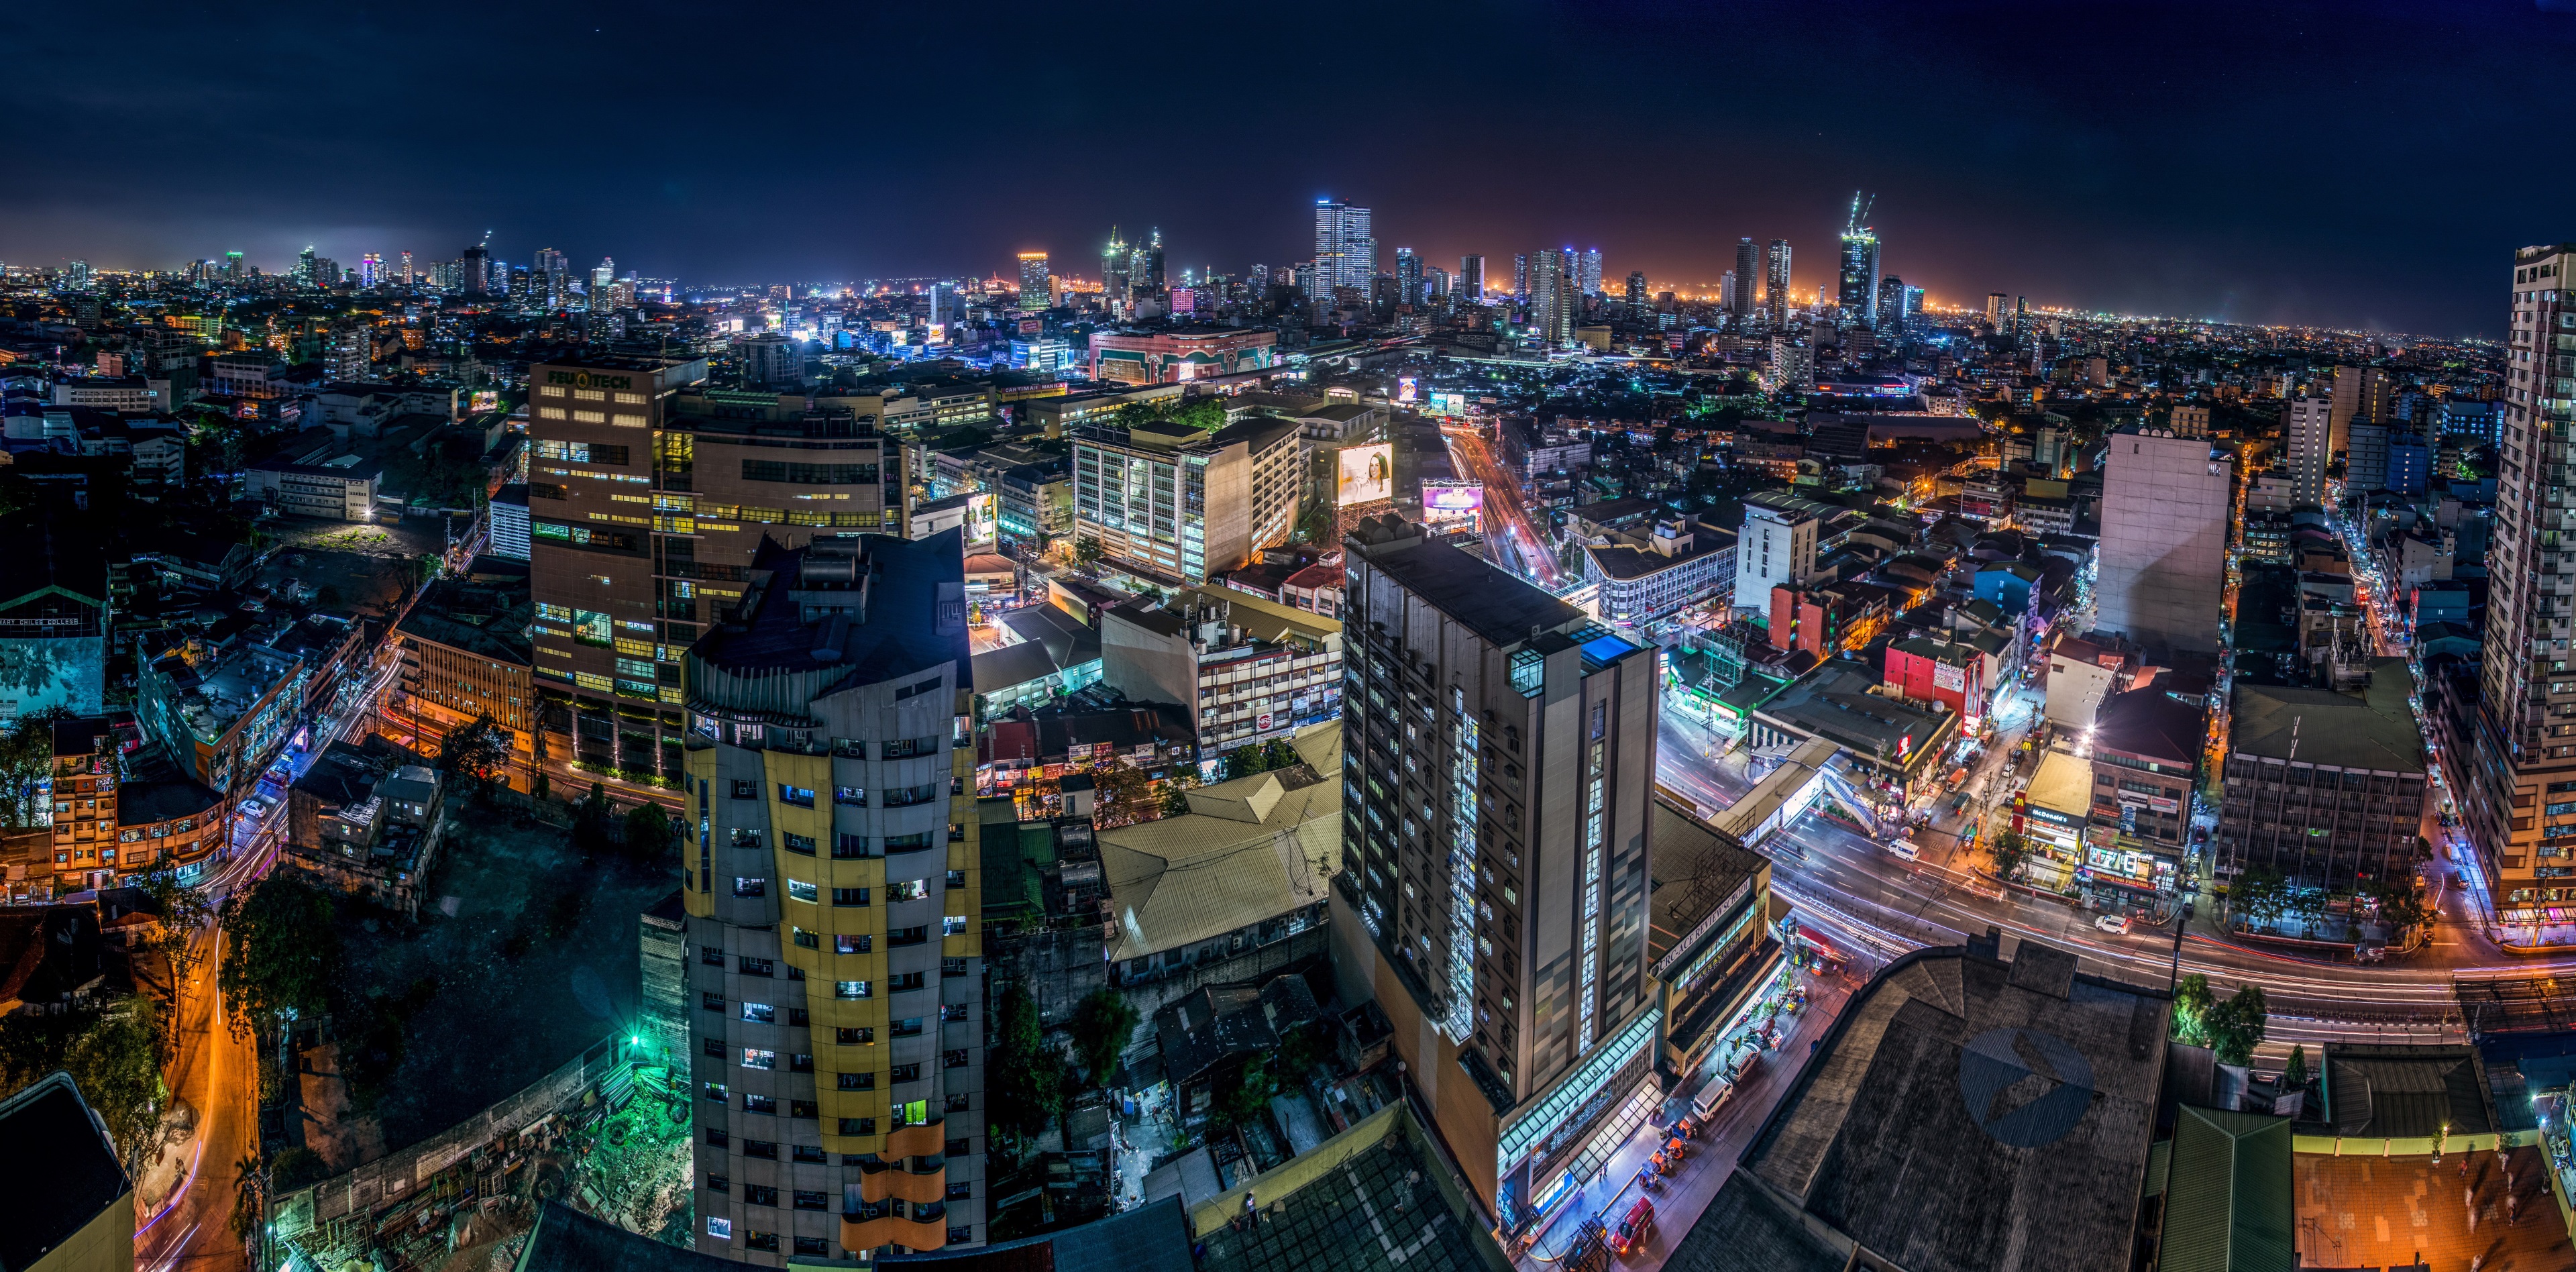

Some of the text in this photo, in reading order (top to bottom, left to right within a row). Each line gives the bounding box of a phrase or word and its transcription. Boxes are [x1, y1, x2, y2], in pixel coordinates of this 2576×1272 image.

[547, 370, 631, 390] FEU TECH
[1005, 385, 1038, 393] CARTIMAR
[1935, 661, 1965, 674] COSMO
[1258, 716, 1272, 725] NRS
[1890, 786, 1904, 796] KFC
[2032, 808, 2068, 823] McDonald's
[1660, 931, 1694, 971] CRC-ACE
[1695, 904, 1723, 940] REVIEW
[1723, 880, 1750, 912] SCHOOL
